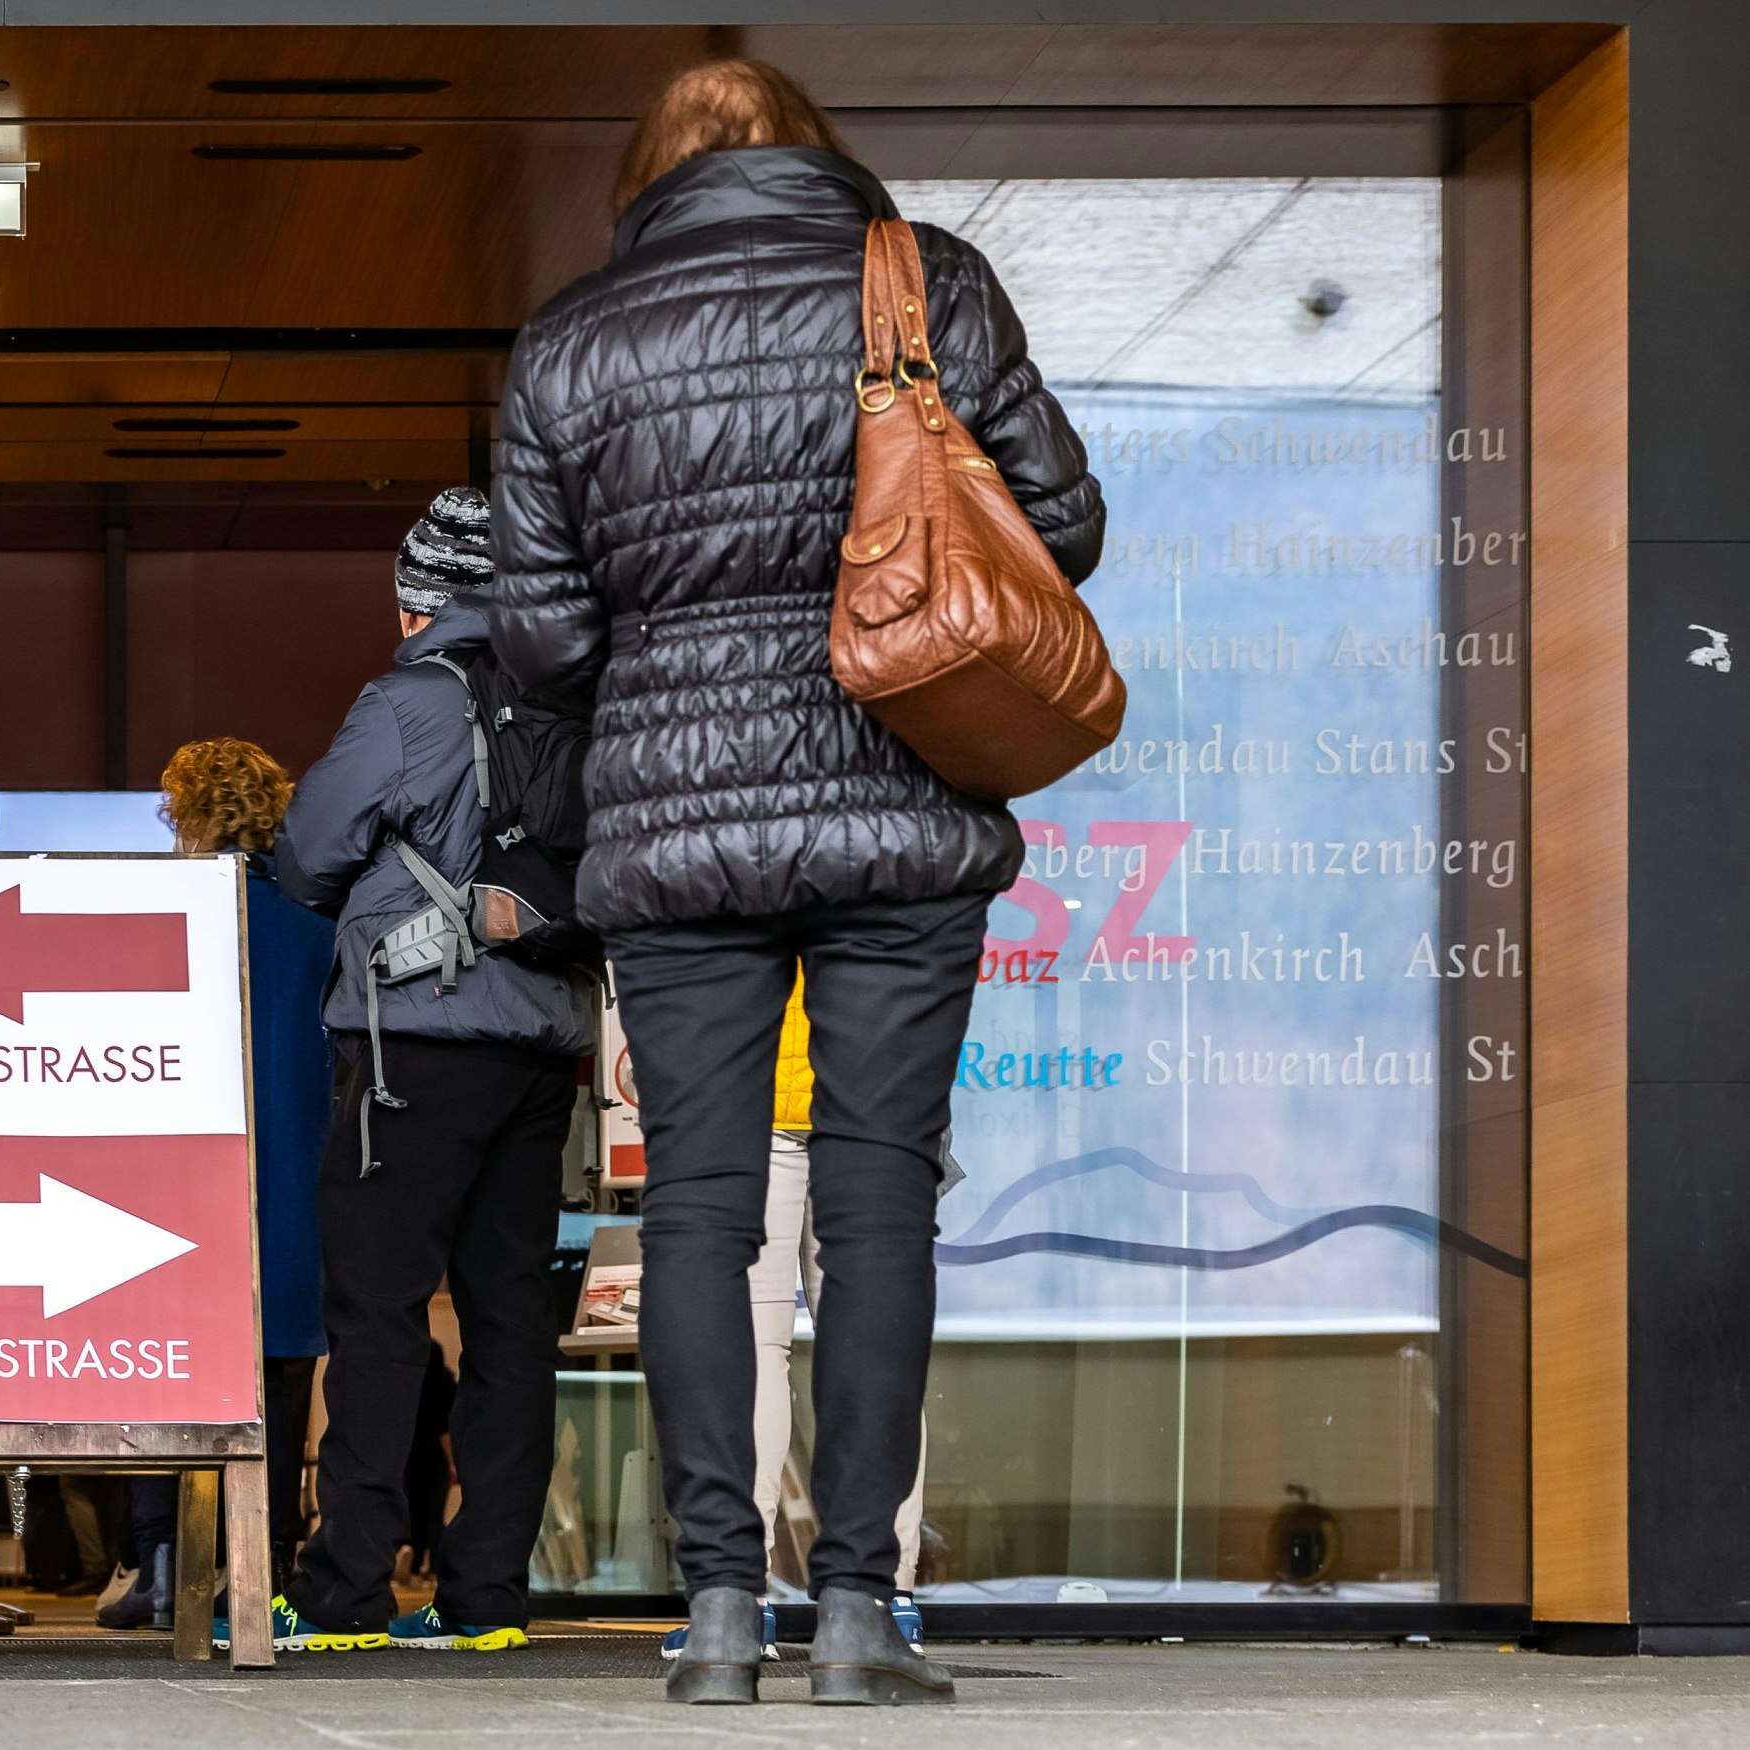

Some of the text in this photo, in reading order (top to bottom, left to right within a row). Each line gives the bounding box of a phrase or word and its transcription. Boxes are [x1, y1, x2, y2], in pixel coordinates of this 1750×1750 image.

[1331, 617, 1517, 669] Aschau
[1316, 727, 1456, 776] Stans
[1191, 825, 1517, 889] Hainzenberg
[1079, 928, 1523, 982] Achenkirch Asch
[954, 1034, 1516, 1090] Reutte Schwendau St
